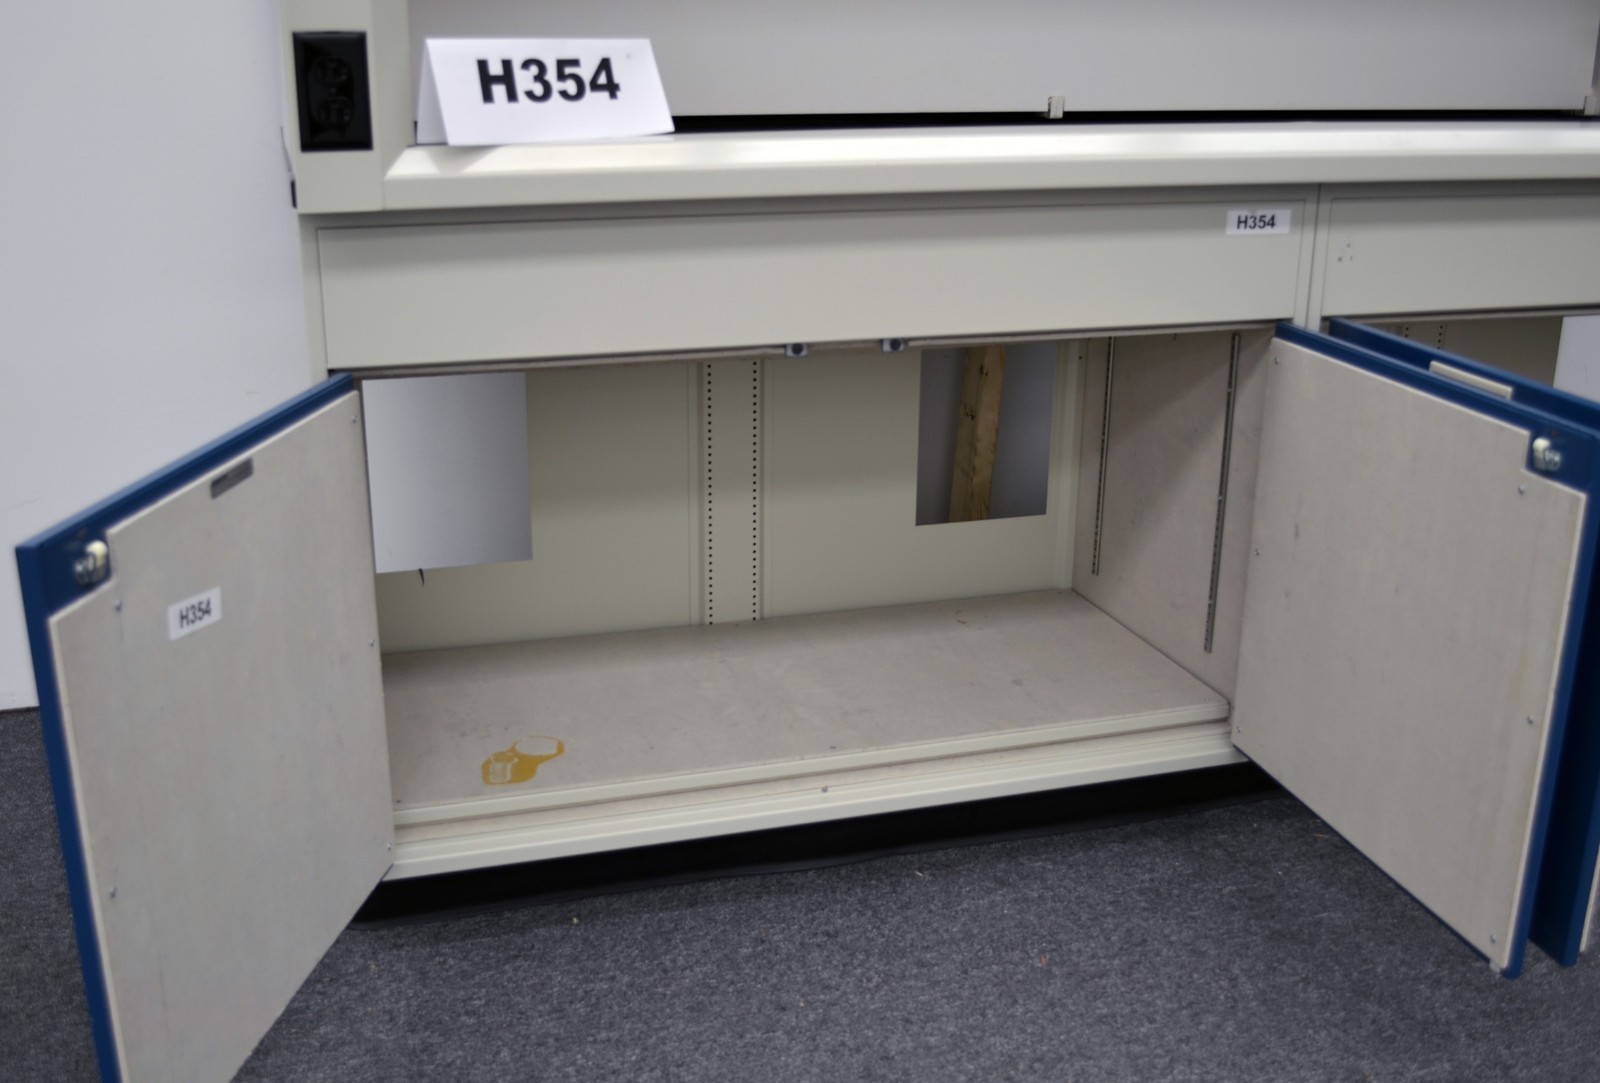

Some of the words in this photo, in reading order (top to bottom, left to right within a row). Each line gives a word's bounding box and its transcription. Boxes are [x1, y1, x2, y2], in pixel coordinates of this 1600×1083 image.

[476, 57, 620, 104] H354
[1236, 214, 1276, 230] H354
[179, 597, 212, 629] H354
